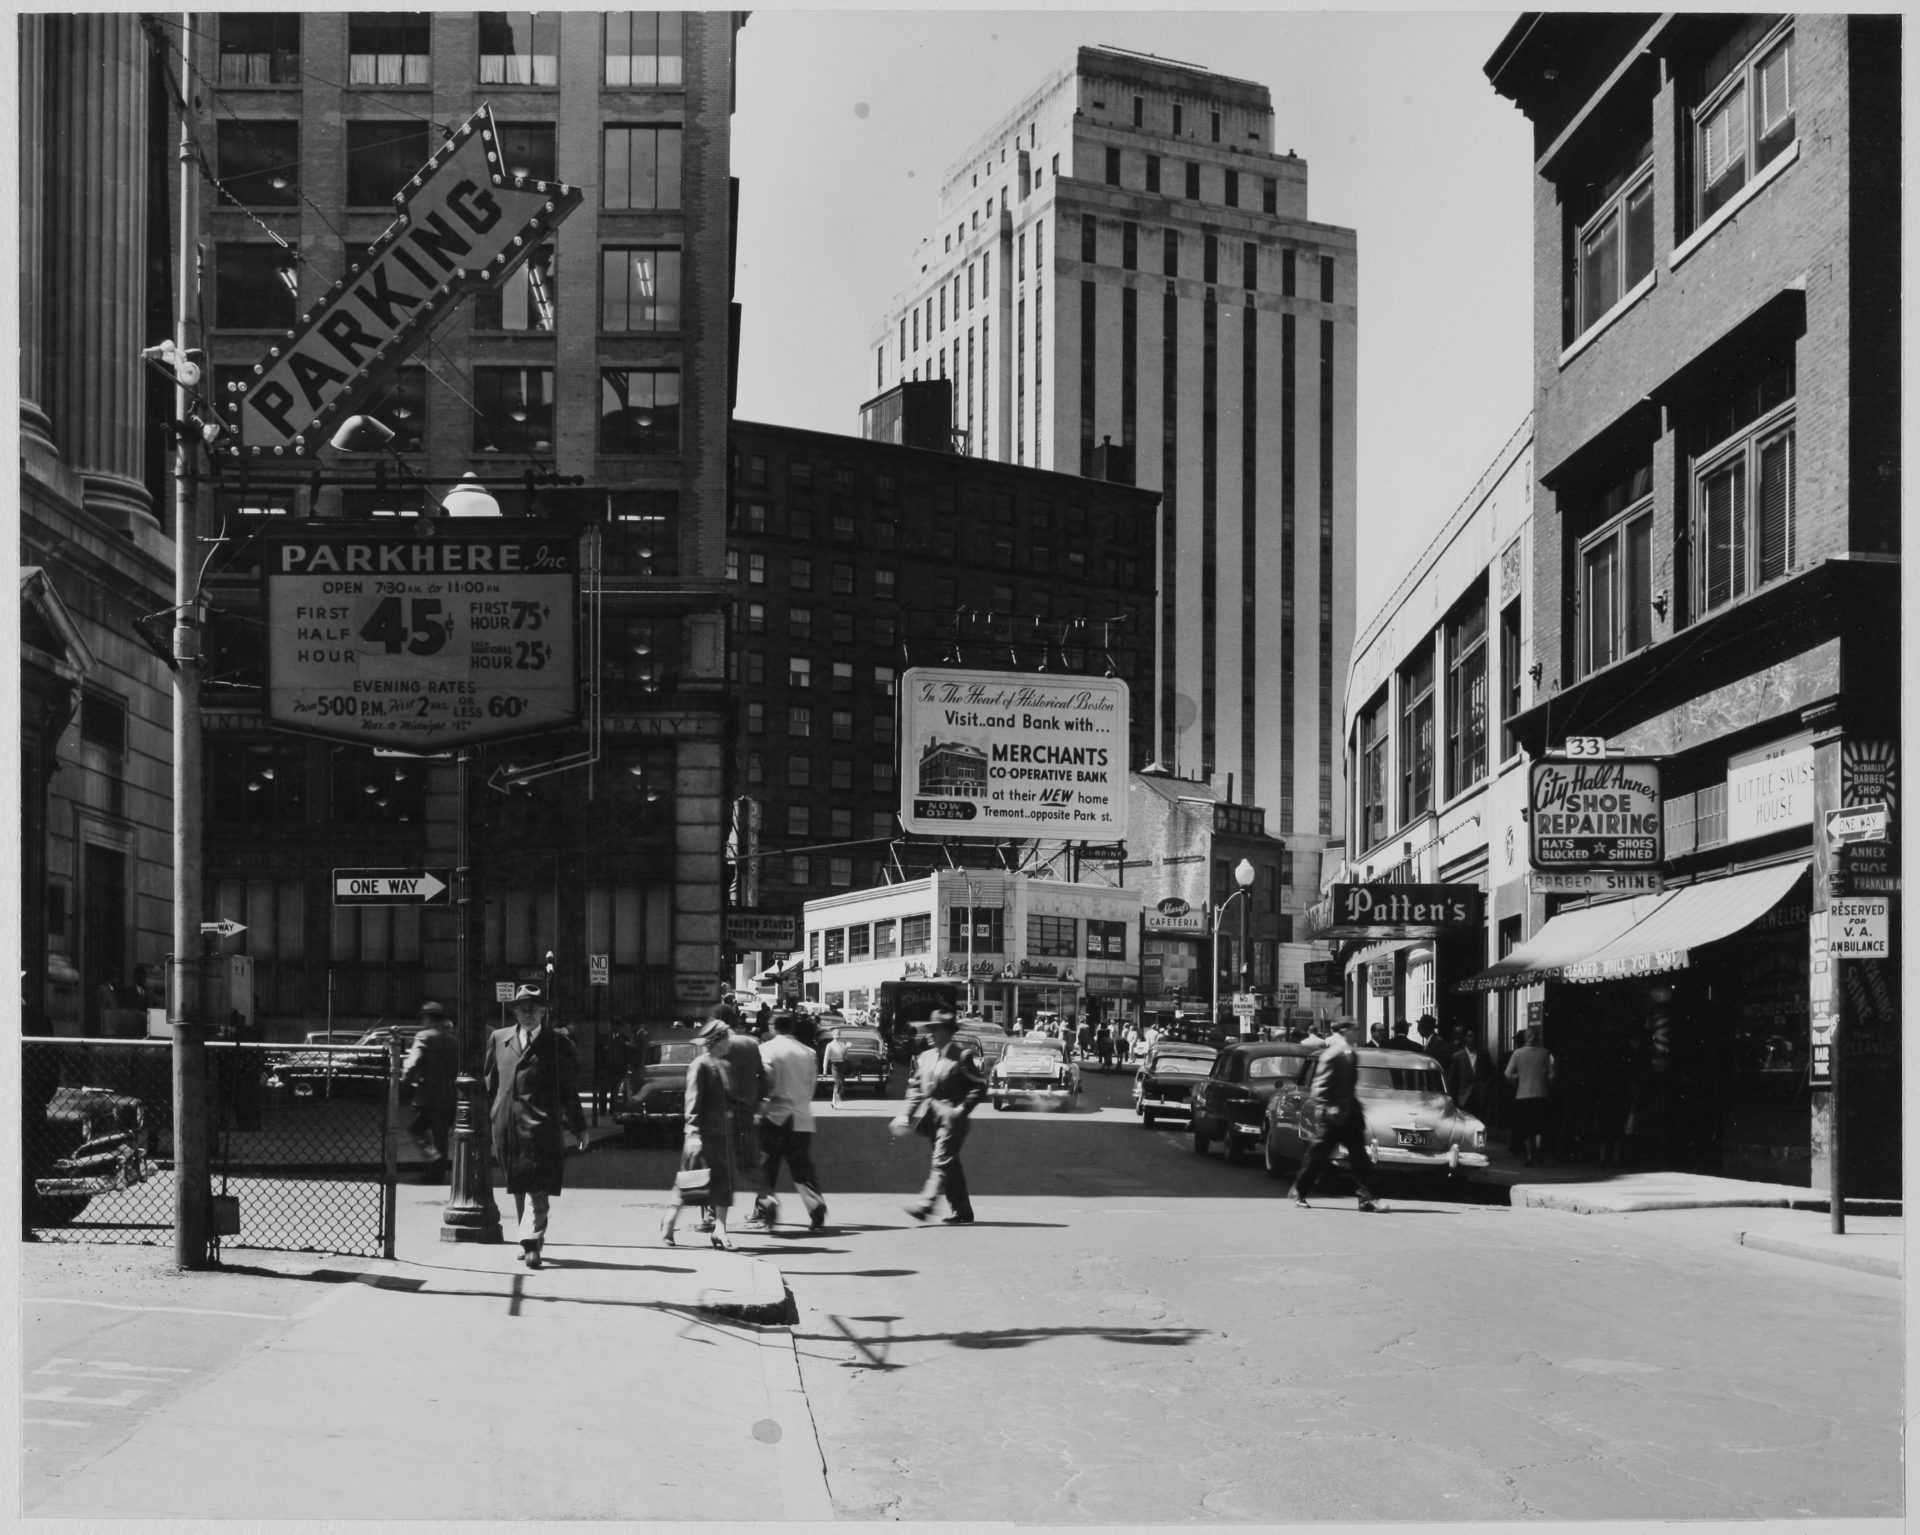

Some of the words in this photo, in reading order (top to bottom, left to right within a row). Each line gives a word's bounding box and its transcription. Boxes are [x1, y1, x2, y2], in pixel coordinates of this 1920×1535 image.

[248, 179, 502, 439] PARKING
[323, 581, 363, 594] OPEN
[375, 582, 406, 594] 7:30
[448, 581, 484, 593] 11:00
[297, 606, 350, 619] FIRST
[470, 602, 510, 614] FIRST
[359, 597, 454, 656] 45¢
[471, 617, 511, 630] HOUR
[298, 628, 350, 640] HALF
[298, 650, 356, 663] HOUR
[471, 656, 513, 668] HOUR
[353, 680, 420, 693] EVENING
[428, 681, 476, 693] RATES
[459, 697, 474, 706] OR
[918, 682, 935, 702] In
[939, 683, 963, 703] The
[963, 683, 1004, 705] Heart
[1003, 692, 1016, 709] of
[1014, 688, 1073, 709] Historical
[1073, 691, 1114, 712] Boston
[318, 696, 357, 716] 5:00
[361, 701, 386, 716] P.M.
[417, 696, 429, 717] 2
[453, 707, 483, 719] LESS
[1023, 714, 1060, 730] Bank
[1571, 739, 1600, 755] 33
[992, 744, 1108, 766] MERCHANTS
[1076, 769, 1108, 783] BANK
[1854, 774, 1886, 785] BARBER
[1534, 768, 1569, 813] City
[1571, 764, 1614, 794] Hall
[1611, 764, 1659, 803] Annex
[1737, 773, 1774, 803] LITTLE
[1858, 785, 1881, 795] SHOP
[992, 790, 1005, 801] at
[1009, 789, 1037, 802] their
[1039, 788, 1074, 802] NEW
[1078, 792, 1109, 805] home
[928, 802, 960, 811] NOW
[1566, 794, 1631, 813] SHOE
[1756, 794, 1793, 825] HOUSE
[926, 809, 964, 819] OPEN
[1074, 810, 1096, 822] Park
[1101, 812, 1113, 822] st.
[1538, 814, 1659, 835] REPAIRING
[1840, 818, 1855, 833] ONE
[1860, 815, 1877, 829] WAY
[1542, 839, 1574, 849] HATS
[1617, 839, 1653, 849] SHOES
[1542, 850, 1589, 860] BLOCKED
[1608, 850, 1653, 860] SHINED
[1851, 847, 1886, 858] ANNEX
[350, 880, 379, 895] ONE
[388, 880, 419, 895] WAY
[1606, 876, 1657, 889] SHINE
[1854, 877, 1894, 891] FRANKLIN
[1345, 887, 1466, 921] Patten's
[1831, 904, 1885, 917] RESERVED
[218, 924, 233, 932] WAY
[763, 919, 794, 930] STATES
[1149, 918, 1199, 927] CAFETERIA
[756, 931, 794, 941] COMPANY
[1844, 927, 1855, 937] V.
[1859, 927, 1873, 937] A.
[1830, 941, 1885, 952] AMBULANCE
[591, 956, 608, 969] NO
[1631, 954, 1650, 970] YOU
